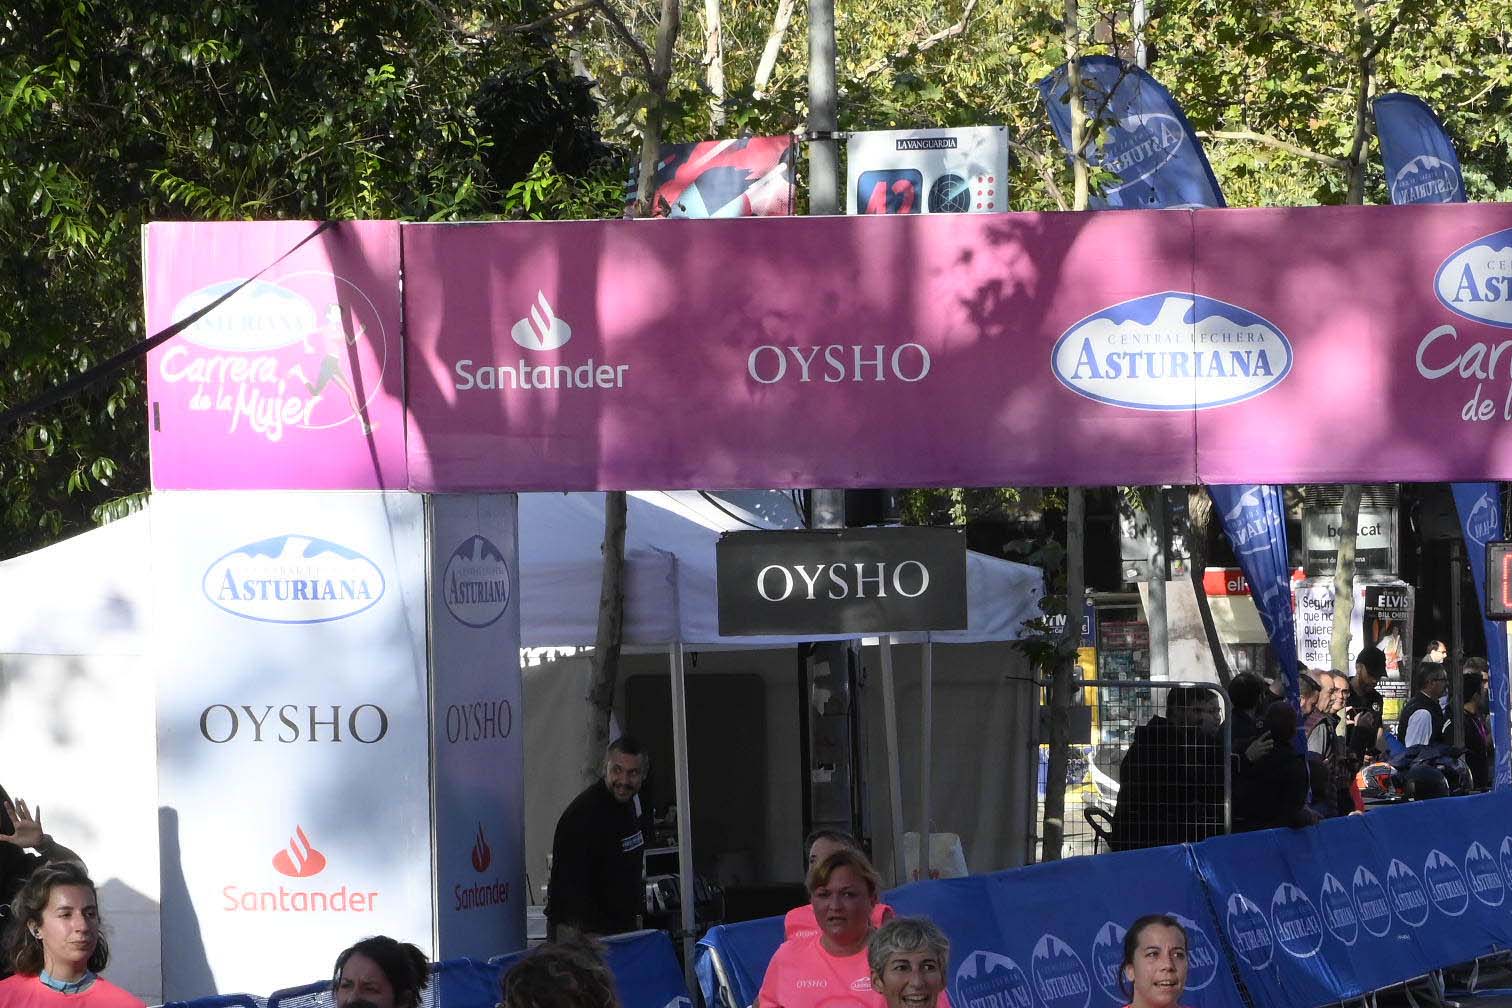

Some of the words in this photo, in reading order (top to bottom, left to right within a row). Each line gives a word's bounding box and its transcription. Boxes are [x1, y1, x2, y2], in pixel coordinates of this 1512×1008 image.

[1107, 331, 1184, 345] CENTRAL
[1189, 330, 1266, 344] LECHERA
[160, 346, 280, 384] Carrera
[456, 358, 628, 390] Santander
[748, 343, 931, 384] OYSHO
[1071, 336, 1274, 381] ASTURIANA
[230, 376, 324, 441] Mujer
[1462, 384, 1496, 421] de
[218, 569, 372, 601] ASTURIANA
[448, 571, 506, 606] ASTURIANA
[757, 560, 930, 601] OYSHO
[200, 703, 389, 744] OYSHO
[446, 700, 512, 744] OYSHO
[223, 886, 378, 912] Santander
[455, 881, 510, 912] Santander
